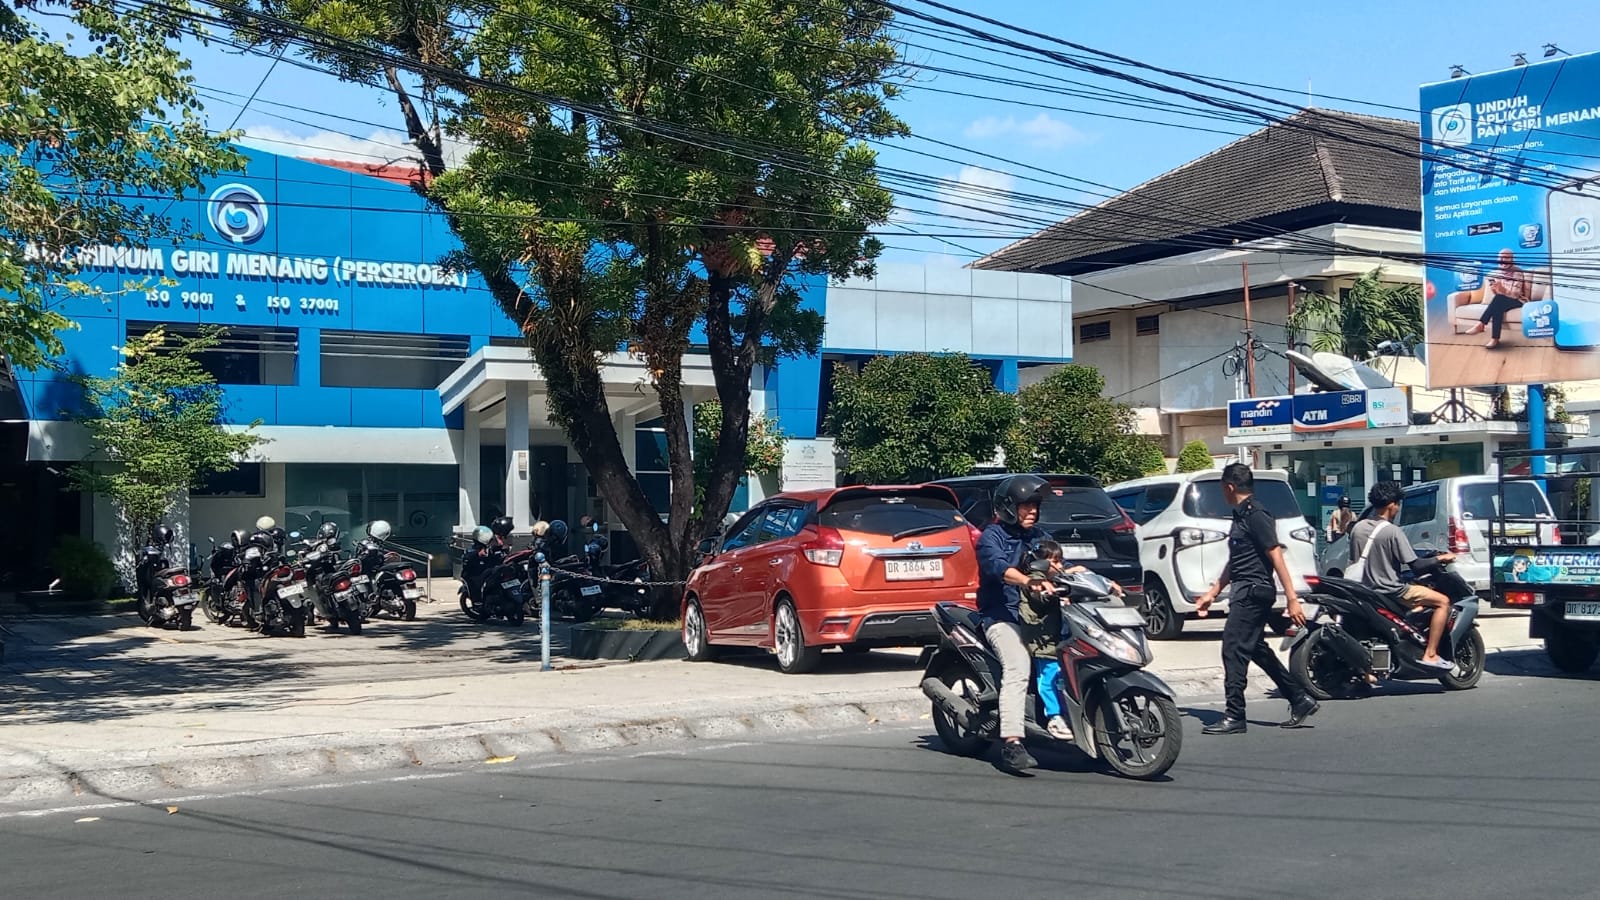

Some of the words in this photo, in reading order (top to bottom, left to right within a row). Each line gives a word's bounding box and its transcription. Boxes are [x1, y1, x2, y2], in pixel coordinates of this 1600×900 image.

[1476, 94, 1528, 114] UNDUH
[1476, 105, 1541, 127] APLIKASI
[1477, 126, 1507, 138] PAM
[1512, 116, 1541, 133] GIRI
[1433, 188, 1449, 197] dan
[1434, 202, 1461, 212] Semua
[1461, 197, 1493, 208] Layanan
[1434, 210, 1452, 221] Satu
[78, 243, 164, 271] MINUM
[171, 249, 219, 274] GIRI
[226, 253, 328, 281] MENANG
[333, 255, 468, 289] (PERSERODA)
[145, 290, 170, 302] ISO
[182, 292, 214, 305] 9001
[235, 294, 246, 306] &
[267, 295, 290, 309] ISO
[300, 297, 339, 311] 37001
[1350, 394, 1361, 403] BRI
[1302, 410, 1327, 422] ATM
[888, 563, 899, 572] DR
[1581, 603, 1600, 614] 817
